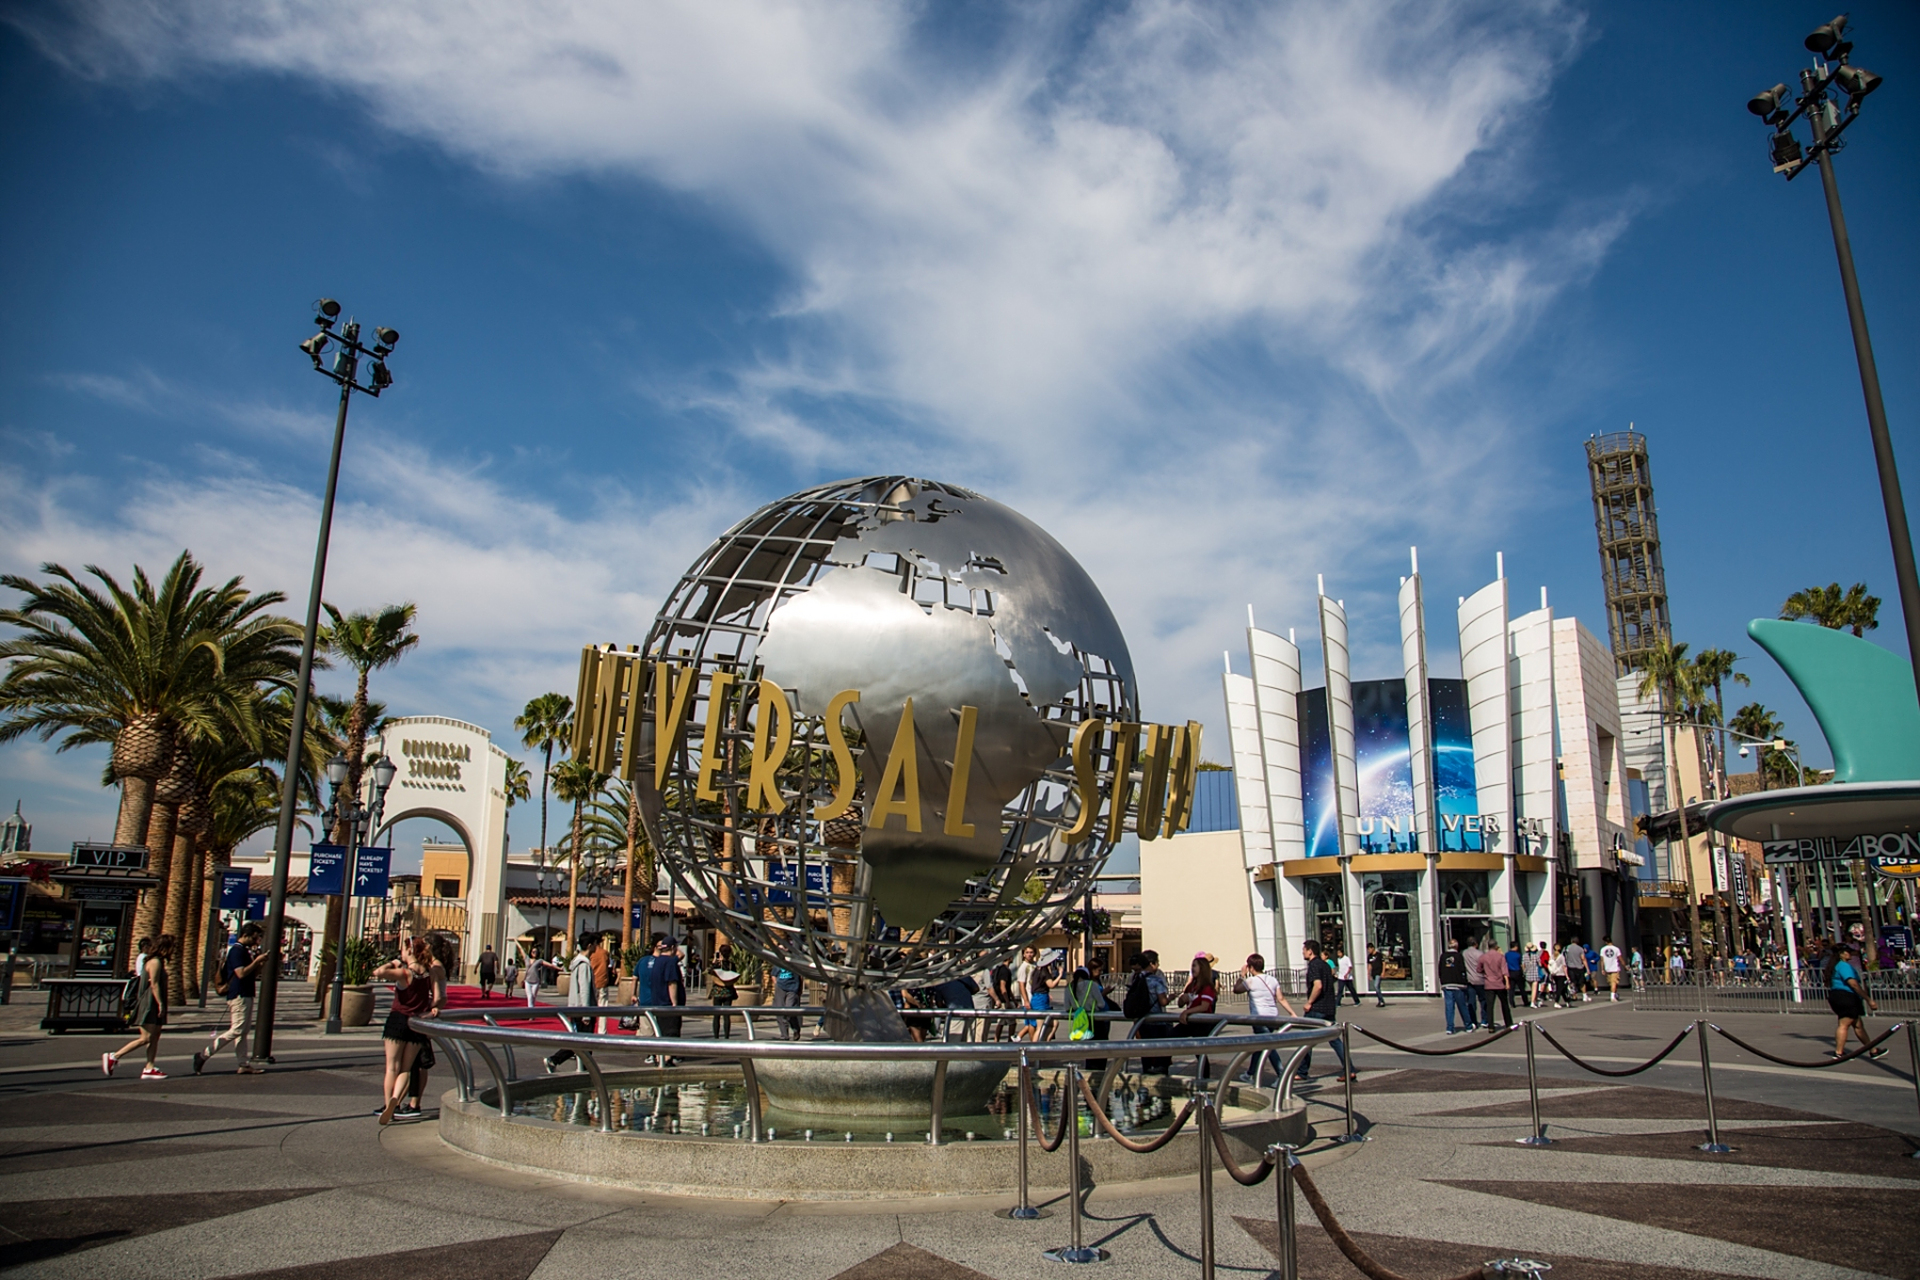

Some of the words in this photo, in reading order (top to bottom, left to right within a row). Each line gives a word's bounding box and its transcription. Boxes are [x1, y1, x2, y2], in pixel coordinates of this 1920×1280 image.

[402, 739, 471, 762] UNIVERSAL
[571, 648, 976, 838] UNIVERSAL
[408, 758, 462, 781] STUDIOS
[93, 851, 126, 866] VIP
